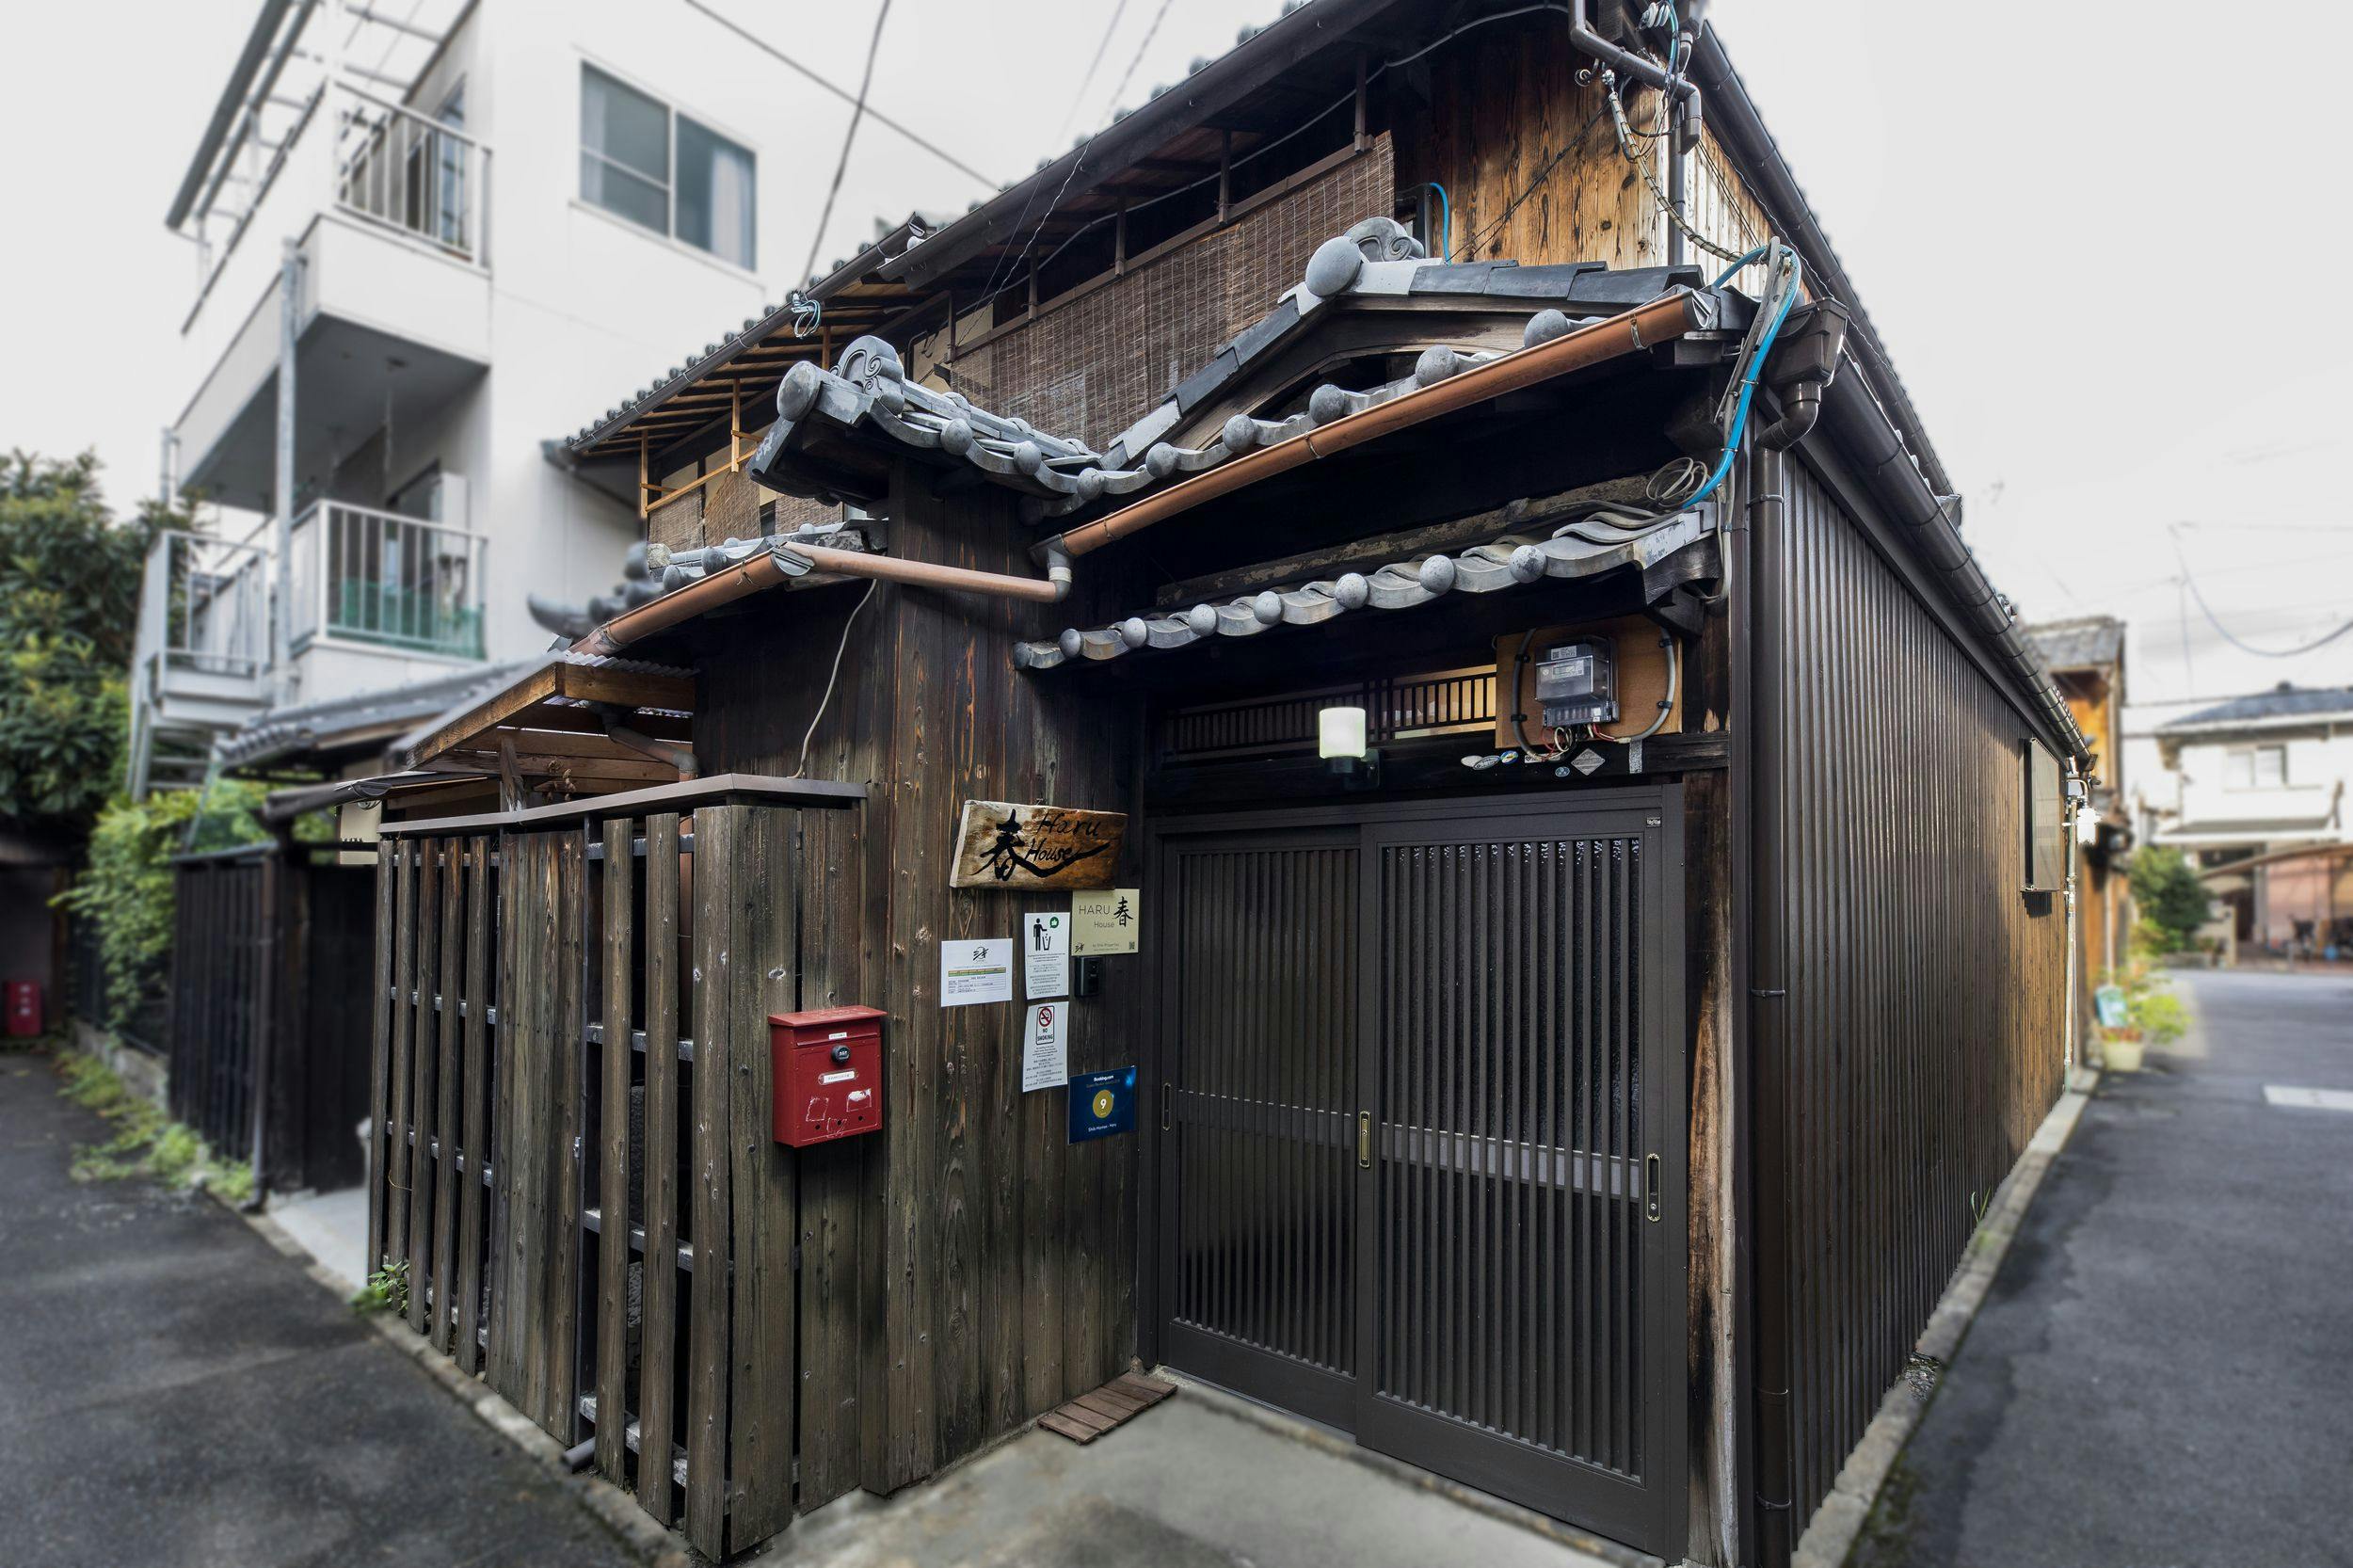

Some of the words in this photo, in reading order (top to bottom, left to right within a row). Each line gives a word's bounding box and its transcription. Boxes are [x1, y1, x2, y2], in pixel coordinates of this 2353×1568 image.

[1036, 811, 1104, 837] Haru
[1027, 837, 1073, 863] House
[1079, 904, 1110, 915] HARU
[1113, 896, 1133, 927] 春
[1100, 1098, 1107, 1109] 9
